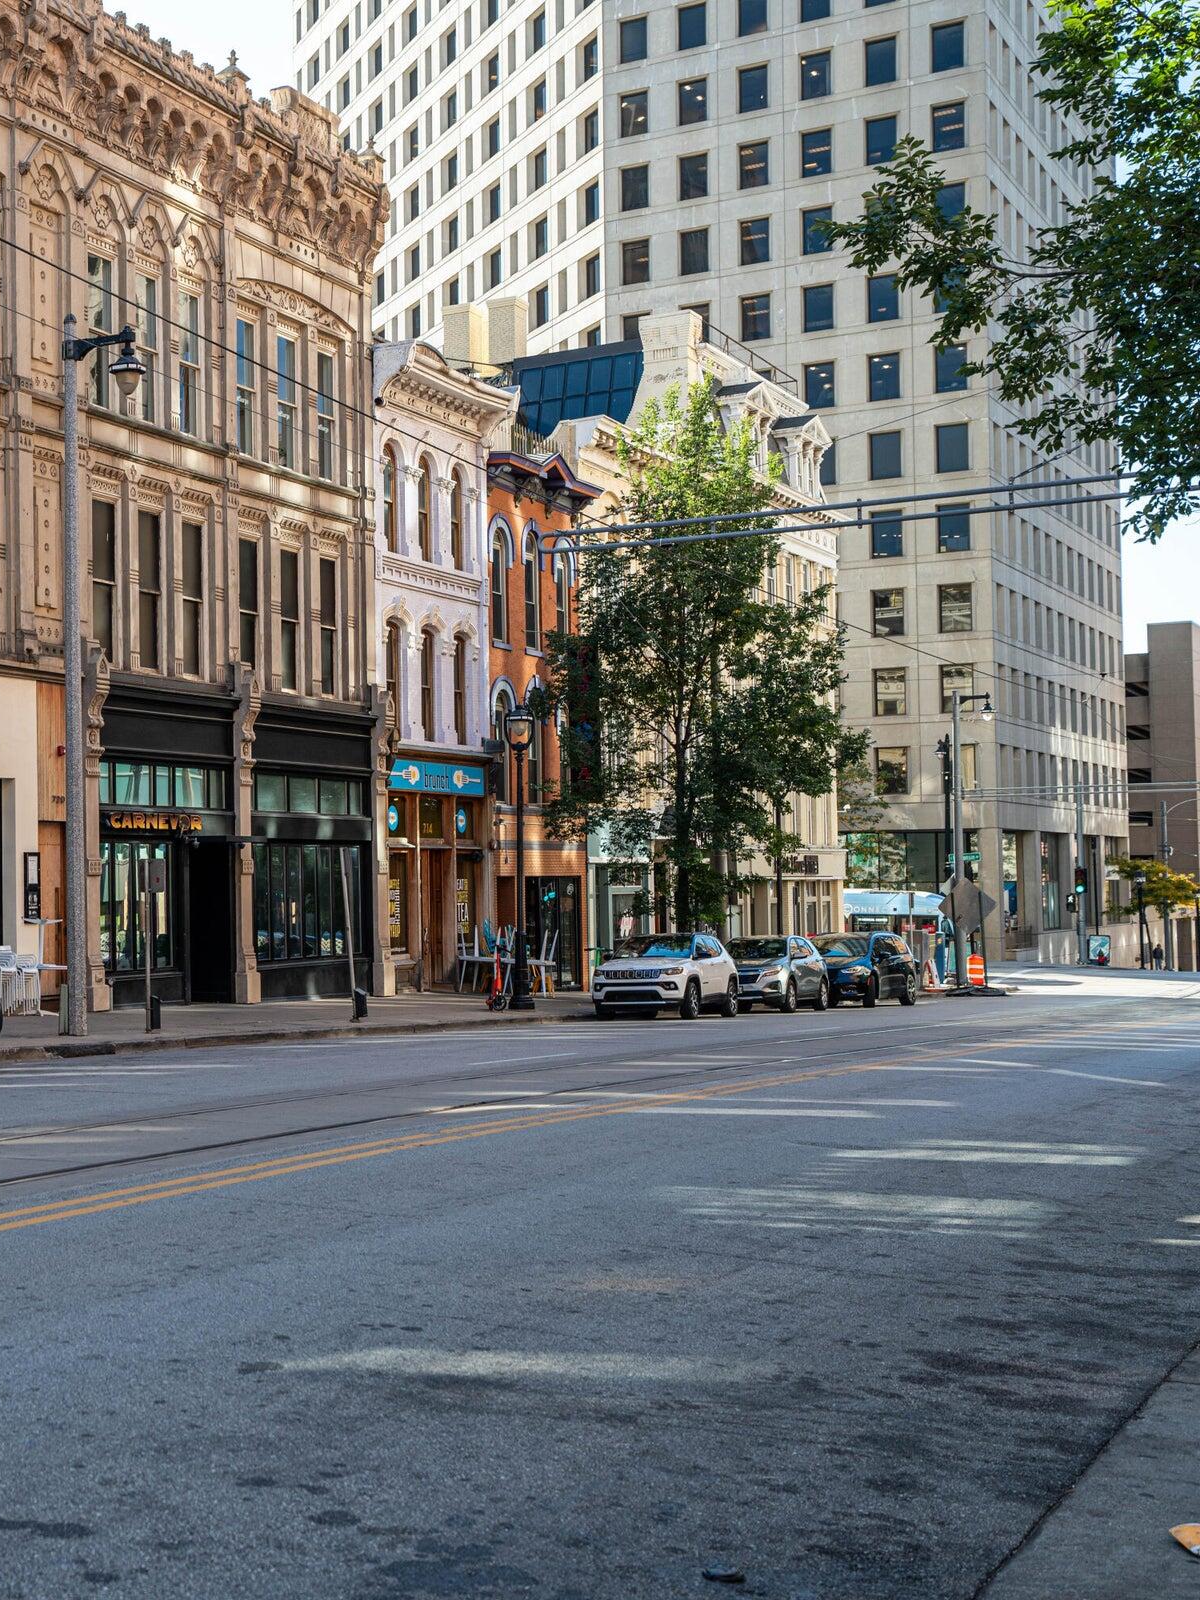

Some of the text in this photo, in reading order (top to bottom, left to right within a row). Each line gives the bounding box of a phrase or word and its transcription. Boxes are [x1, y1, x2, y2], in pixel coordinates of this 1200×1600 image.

[424, 764, 450, 789] brunch
[110, 811, 203, 833] CARNEVOR
[457, 903, 469, 922] TEA
